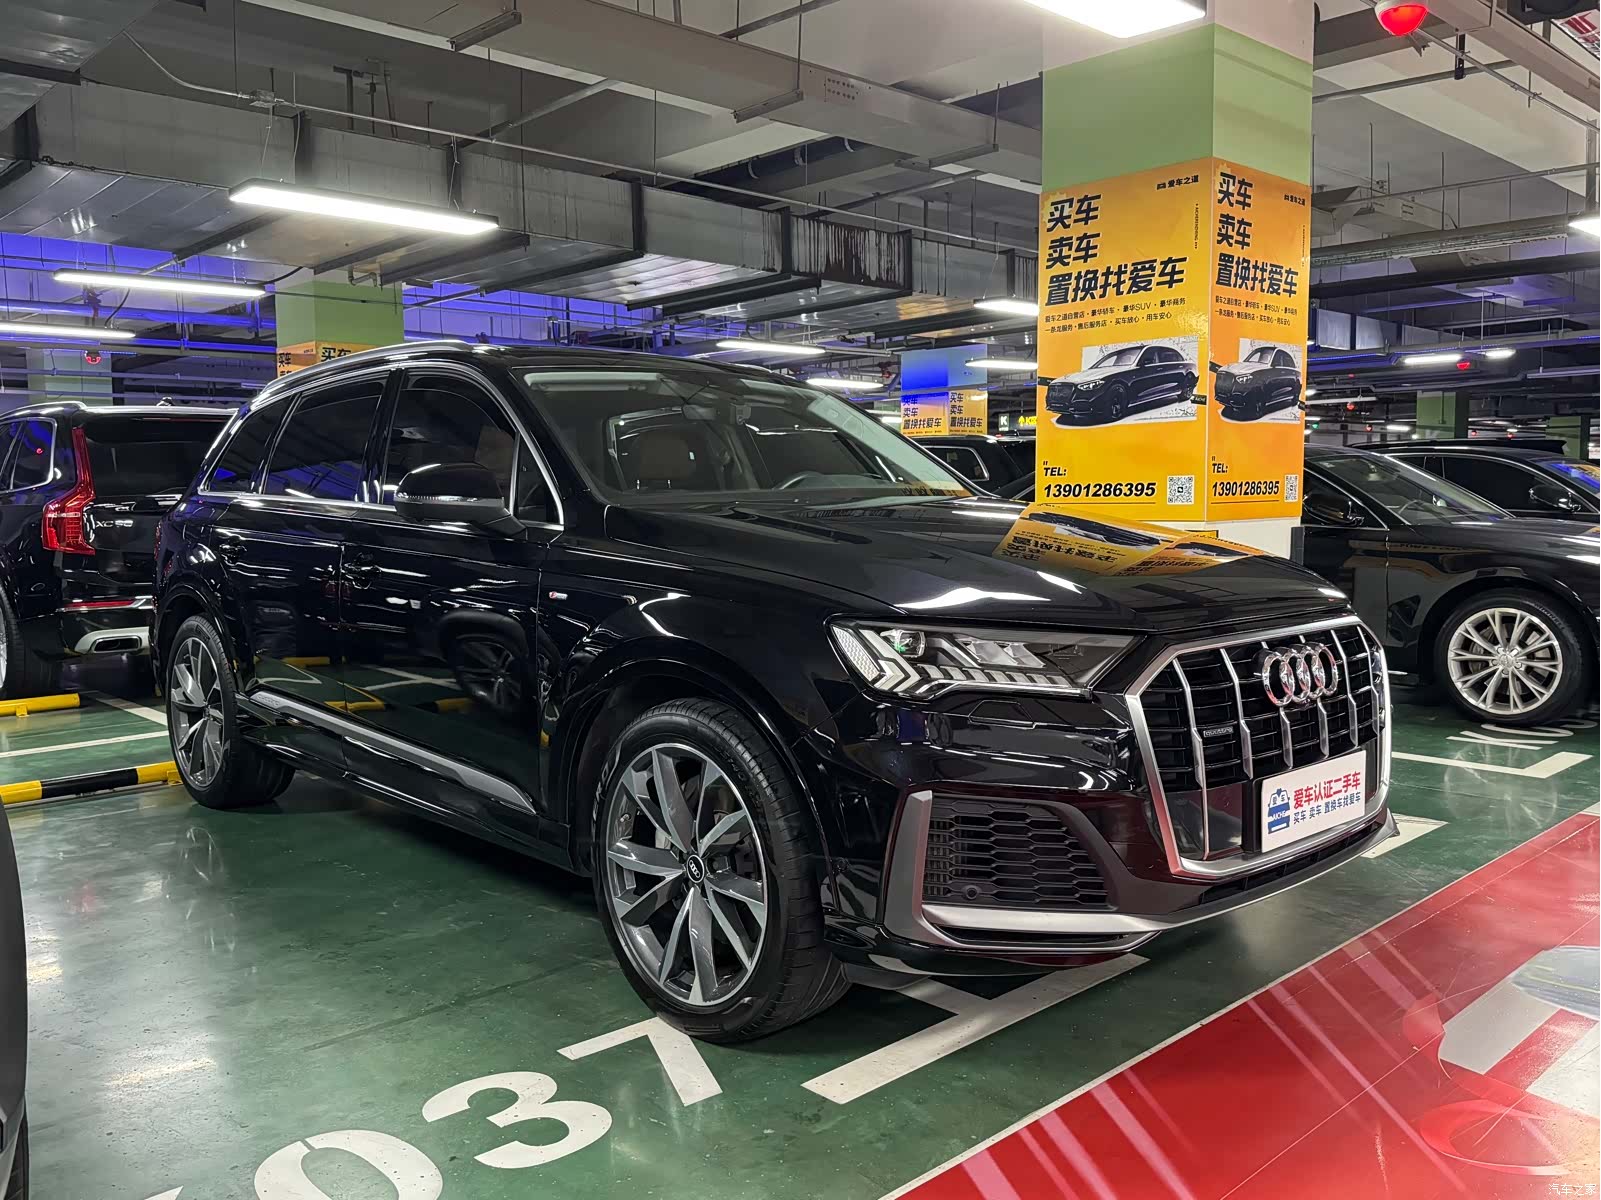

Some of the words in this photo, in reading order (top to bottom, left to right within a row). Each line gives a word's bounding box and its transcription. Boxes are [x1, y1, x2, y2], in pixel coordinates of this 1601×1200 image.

[1168, 175, 1199, 188] 爱车之道
[1217, 172, 1253, 210] 买车
[1046, 194, 1101, 232] 买车
[1217, 213, 1252, 250] 卖车
[1046, 232, 1101, 269] 卖车
[1044, 256, 1187, 306] 置换找爱车
[1216, 252, 1298, 298] 置换找爱车
[903, 417, 942, 430] 置换找爱车
[949, 416, 983, 427] 置换找爱车
[1000, 415, 1008, 425] K
[1043, 467, 1067, 476] TEL:
[1212, 463, 1228, 473] TEL:
[1044, 482, 1156, 498] 13901286395
[1212, 480, 1280, 497] 13901286395
[1293, 771, 1361, 810] 爱车认证二手车
[1293, 810, 1307, 825] 买车
[1308, 804, 1322, 819] 卖车
[1324, 791, 1361, 814] 置换车找爱车
